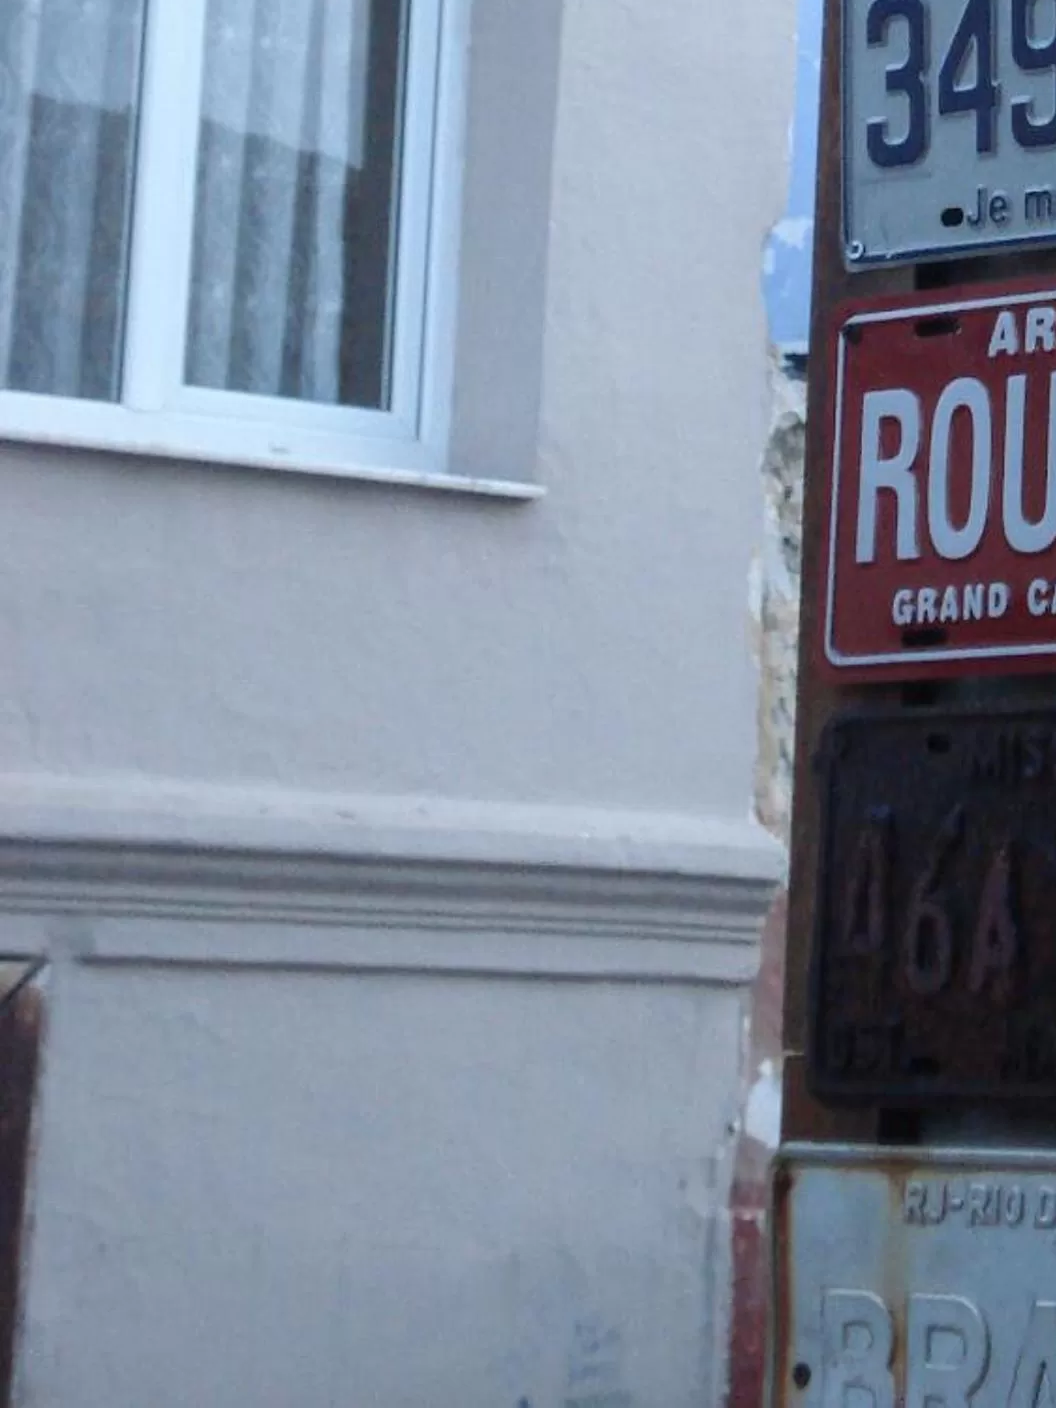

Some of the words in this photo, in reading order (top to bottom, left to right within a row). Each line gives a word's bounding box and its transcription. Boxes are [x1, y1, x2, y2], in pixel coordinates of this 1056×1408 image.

[967, 187, 1010, 228] Je
[891, 582, 1010, 626] GRAND
[902, 1183, 1026, 1227] RJ-RIO
